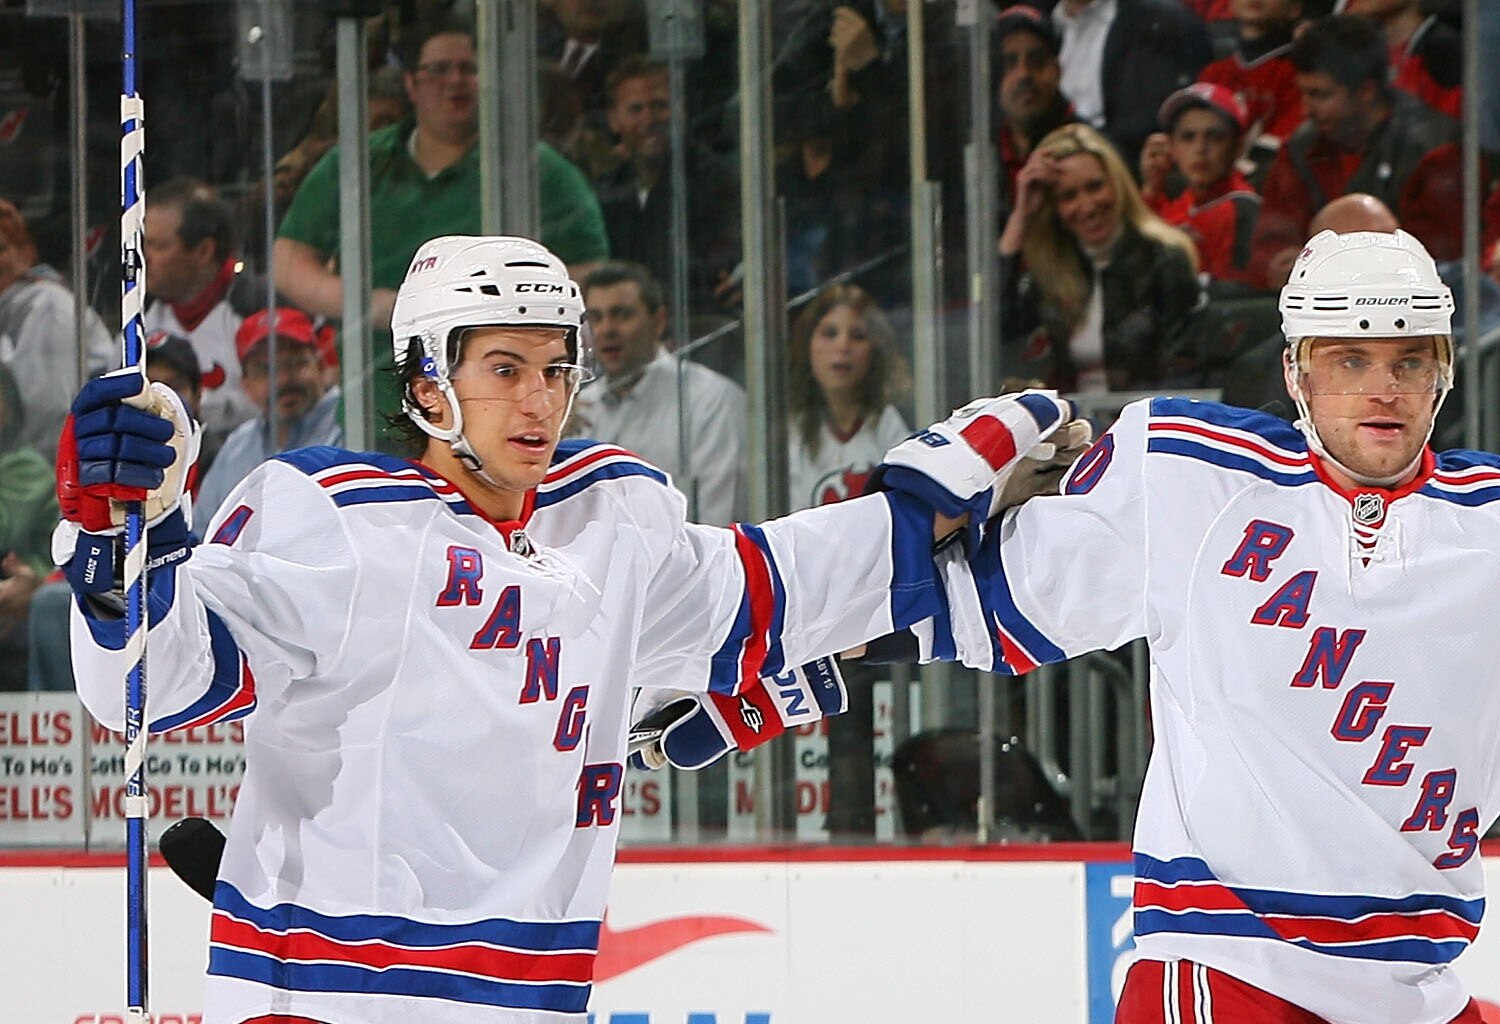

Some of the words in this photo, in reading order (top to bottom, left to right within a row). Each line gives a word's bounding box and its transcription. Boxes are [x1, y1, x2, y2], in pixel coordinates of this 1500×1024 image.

[515, 283, 563, 294] CCM
[1355, 296, 1409, 306] BAUER
[435, 544, 623, 829] RANGR
[1220, 518, 1479, 871] RANGERS
[3, 756, 25, 775] To
[30, 755, 73, 775] Mo's
[176, 755, 201, 774] To
